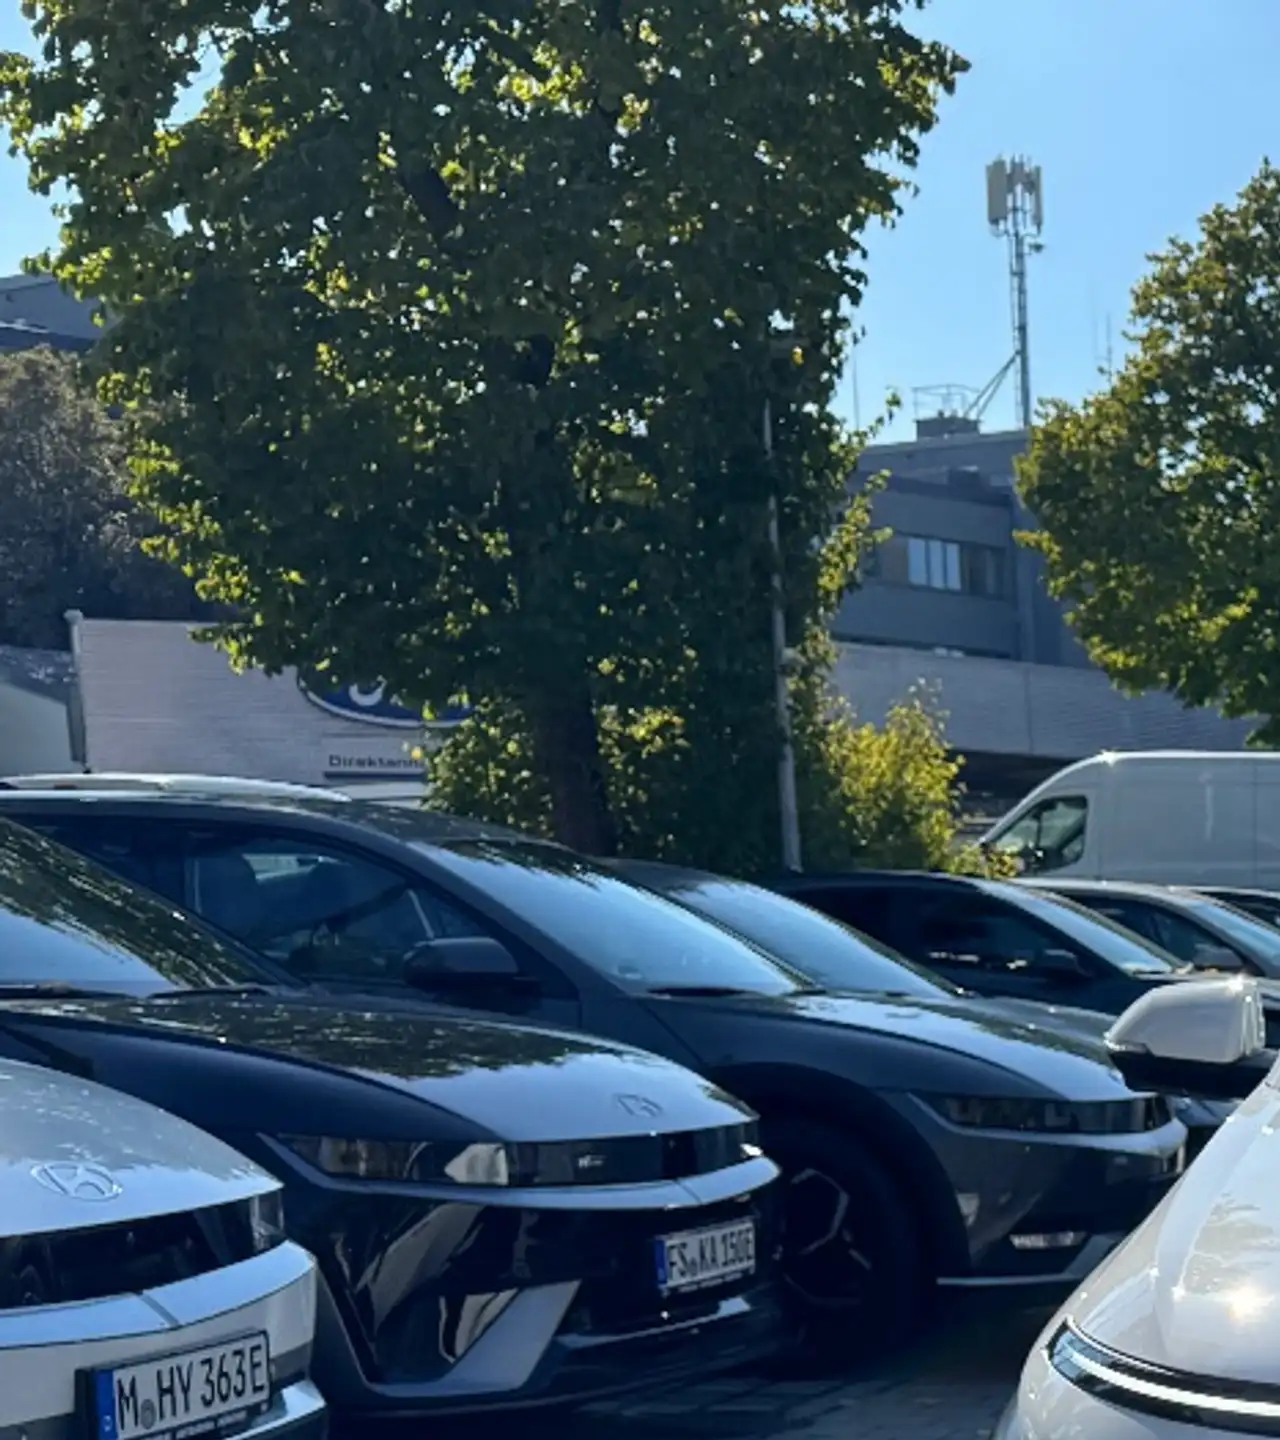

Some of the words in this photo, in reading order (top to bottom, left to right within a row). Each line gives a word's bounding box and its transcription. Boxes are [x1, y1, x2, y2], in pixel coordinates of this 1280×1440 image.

[117, 1375, 139, 1430] M
[156, 1361, 194, 1420] HY
[200, 1344, 265, 1408] 363E
